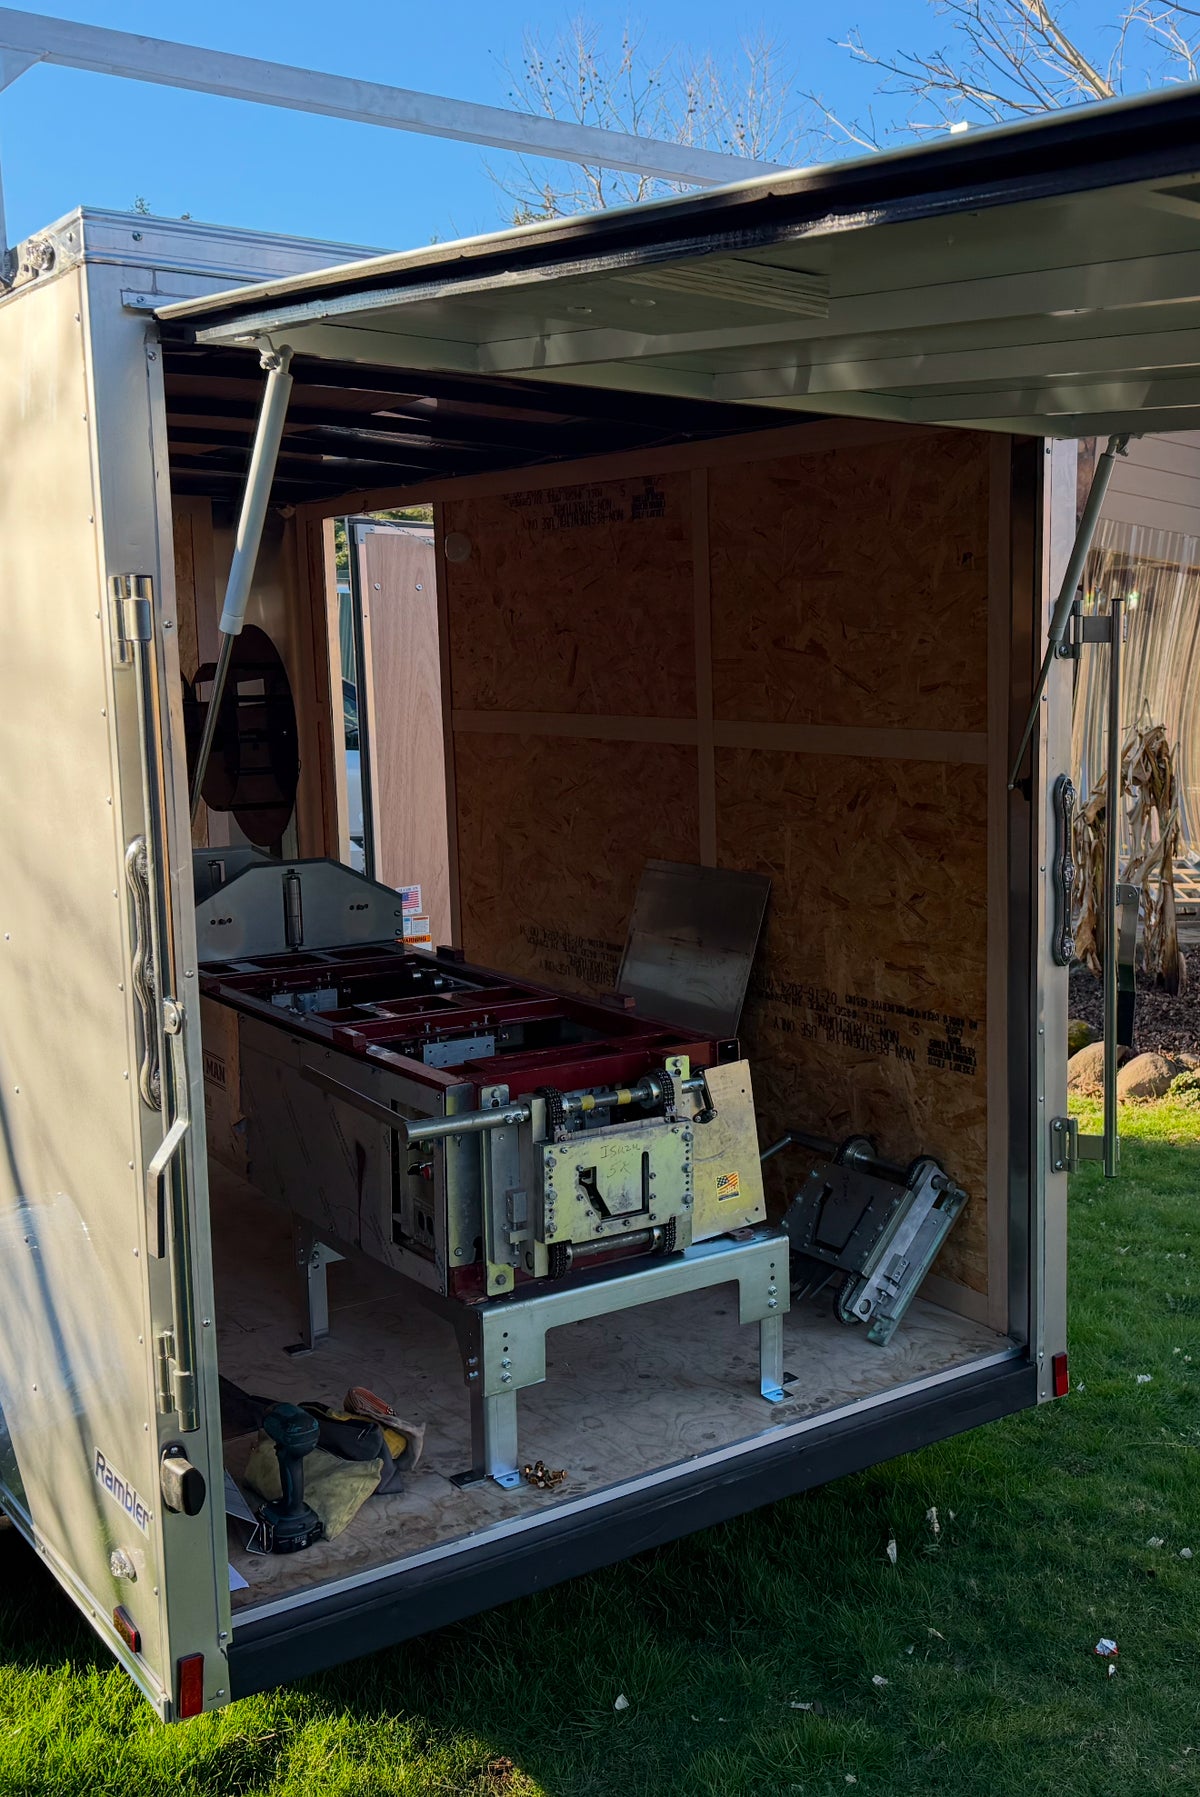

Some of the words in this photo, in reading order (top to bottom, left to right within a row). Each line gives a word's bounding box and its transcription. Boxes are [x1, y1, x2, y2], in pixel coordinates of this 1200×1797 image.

[773, 1016, 795, 1032] ONLY
[800, 1022, 817, 1039] USE
[816, 1013, 900, 1044] NON-STRUCTURAL
[912, 1021, 920, 1036] S
[825, 1027, 915, 1062] NON-RESIDENTIAL
[203, 1056, 225, 1084] MAN
[96, 1450, 149, 1530] Rambler
